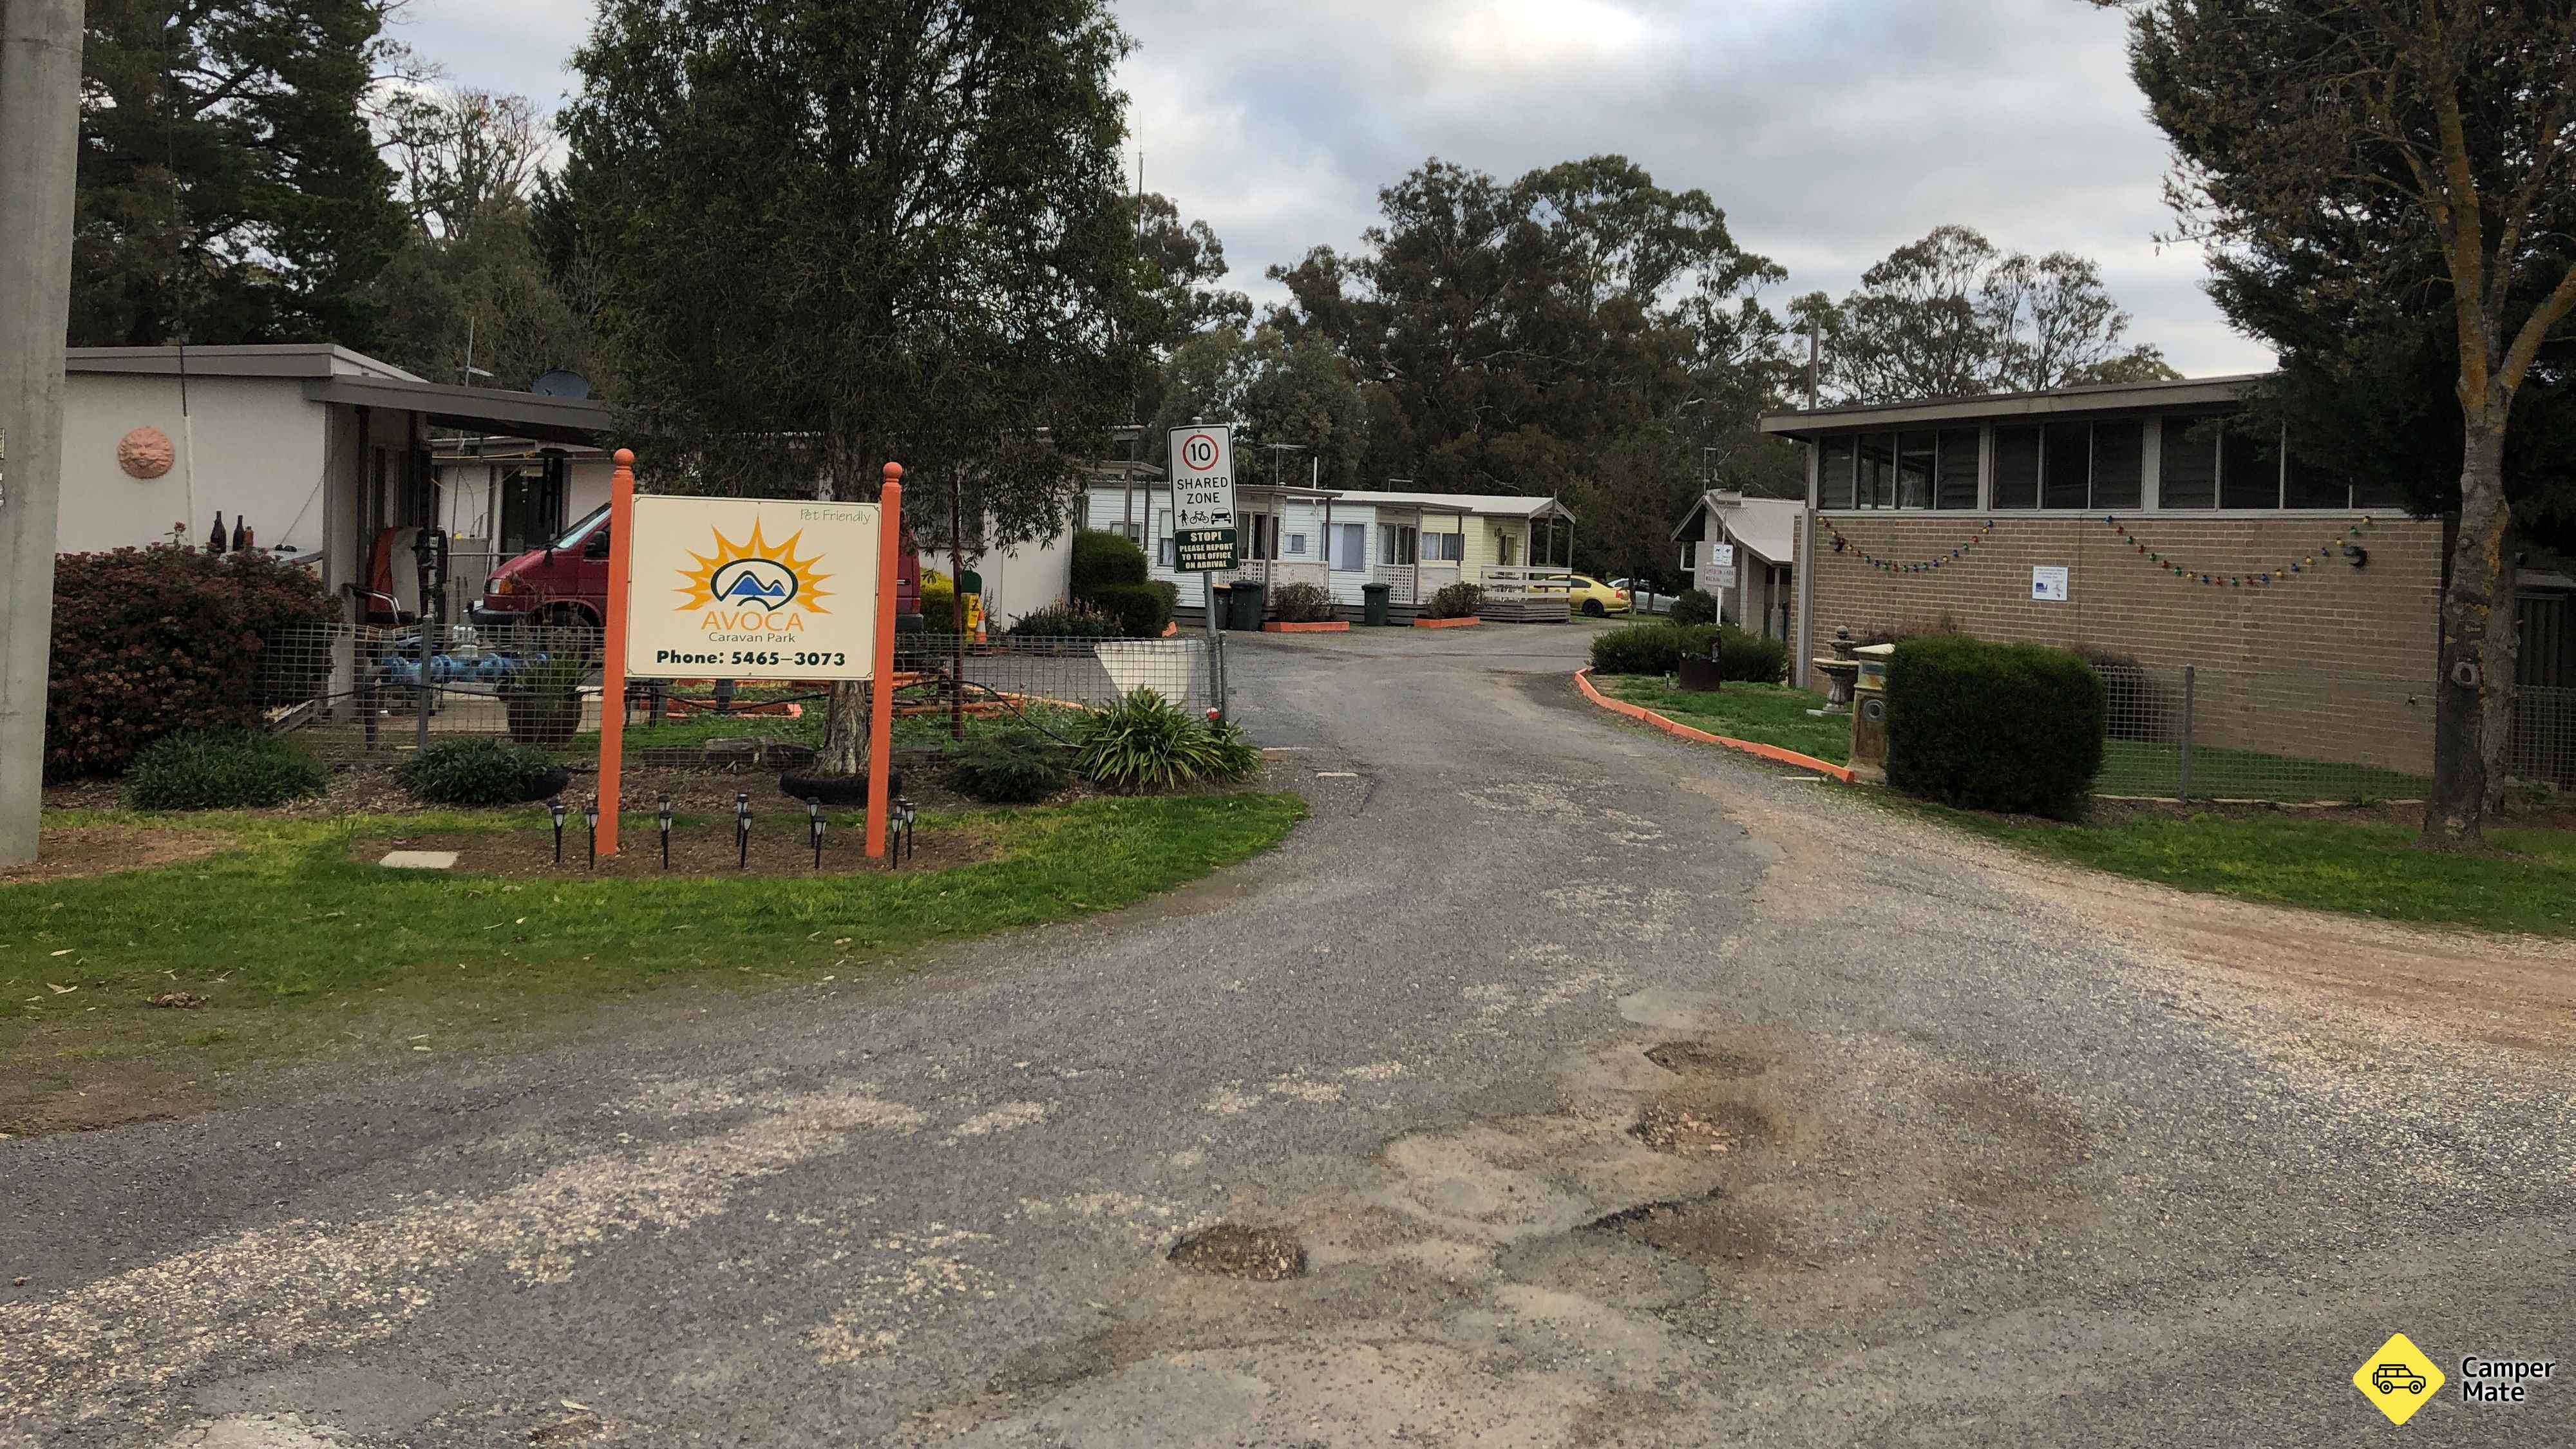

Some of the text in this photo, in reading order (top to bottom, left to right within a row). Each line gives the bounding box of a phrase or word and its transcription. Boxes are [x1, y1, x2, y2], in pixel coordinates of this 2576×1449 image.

[1191, 443, 1211, 462] 10
[1177, 477, 1228, 490] SHARED
[1187, 492, 1220, 504] ZONE
[800, 509, 871, 525] Pet Friendly
[1190, 531, 1222, 542] STOP!
[1206, 543, 1233, 551] REPORT
[701, 611, 804, 631] AVOCA
[709, 632, 796, 643] Caravan Park
[657, 650, 724, 665] Phone:
